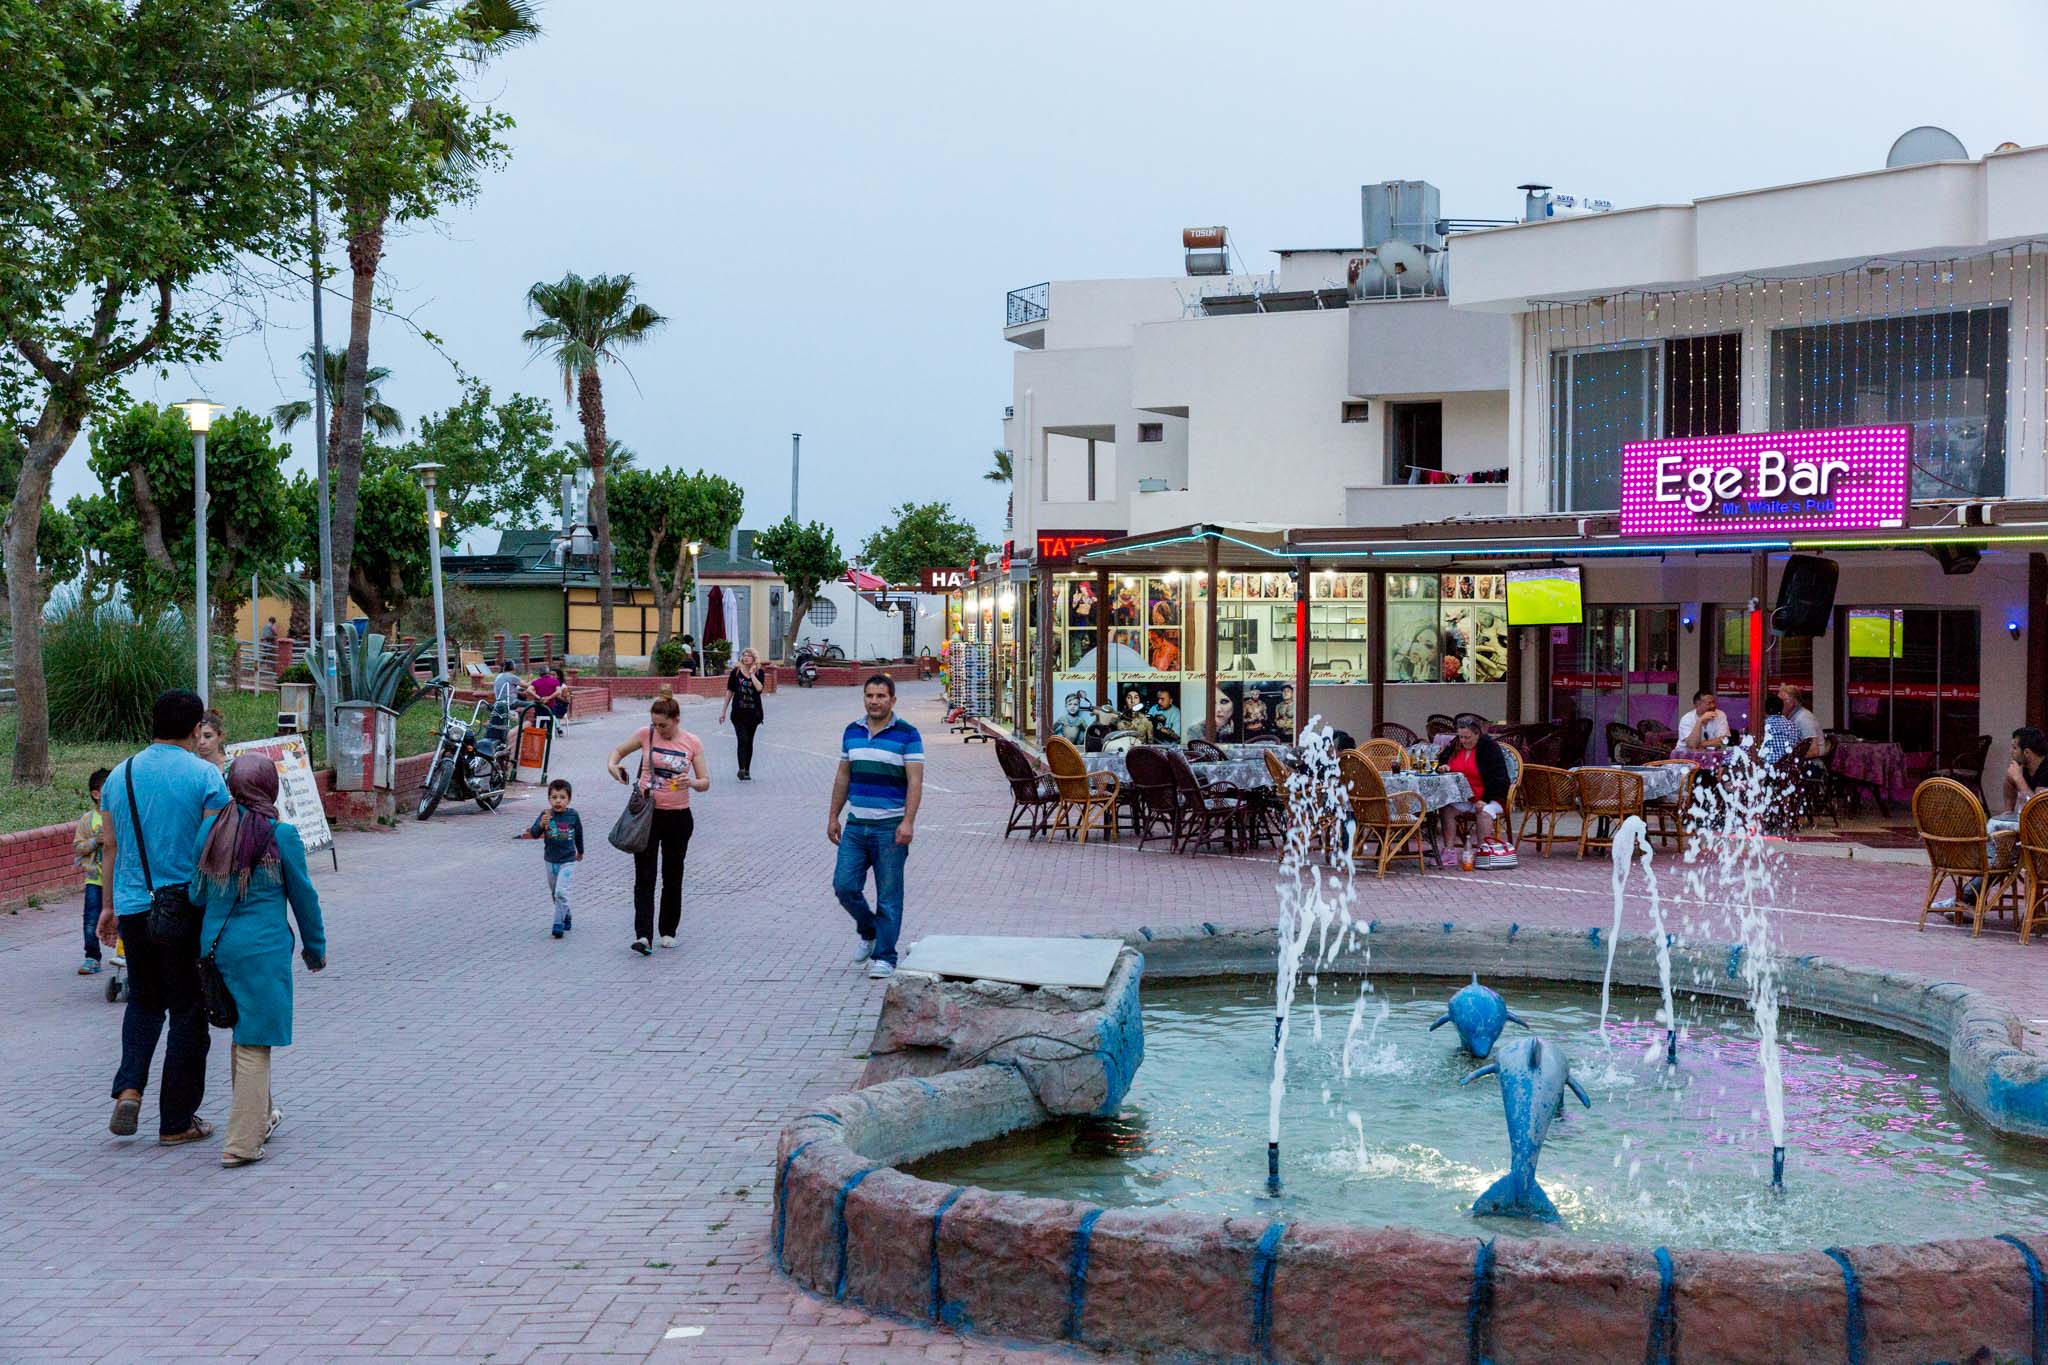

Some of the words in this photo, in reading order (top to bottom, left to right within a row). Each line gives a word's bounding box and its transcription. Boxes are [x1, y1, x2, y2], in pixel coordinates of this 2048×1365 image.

[1190, 229, 1217, 238] TOSUN
[1655, 456, 1743, 512] Ege
[1758, 450, 1849, 498] Bar
[1721, 501, 1743, 515] Mr.
[1747, 499, 1801, 514] White's
[1805, 498, 1836, 512] Pub
